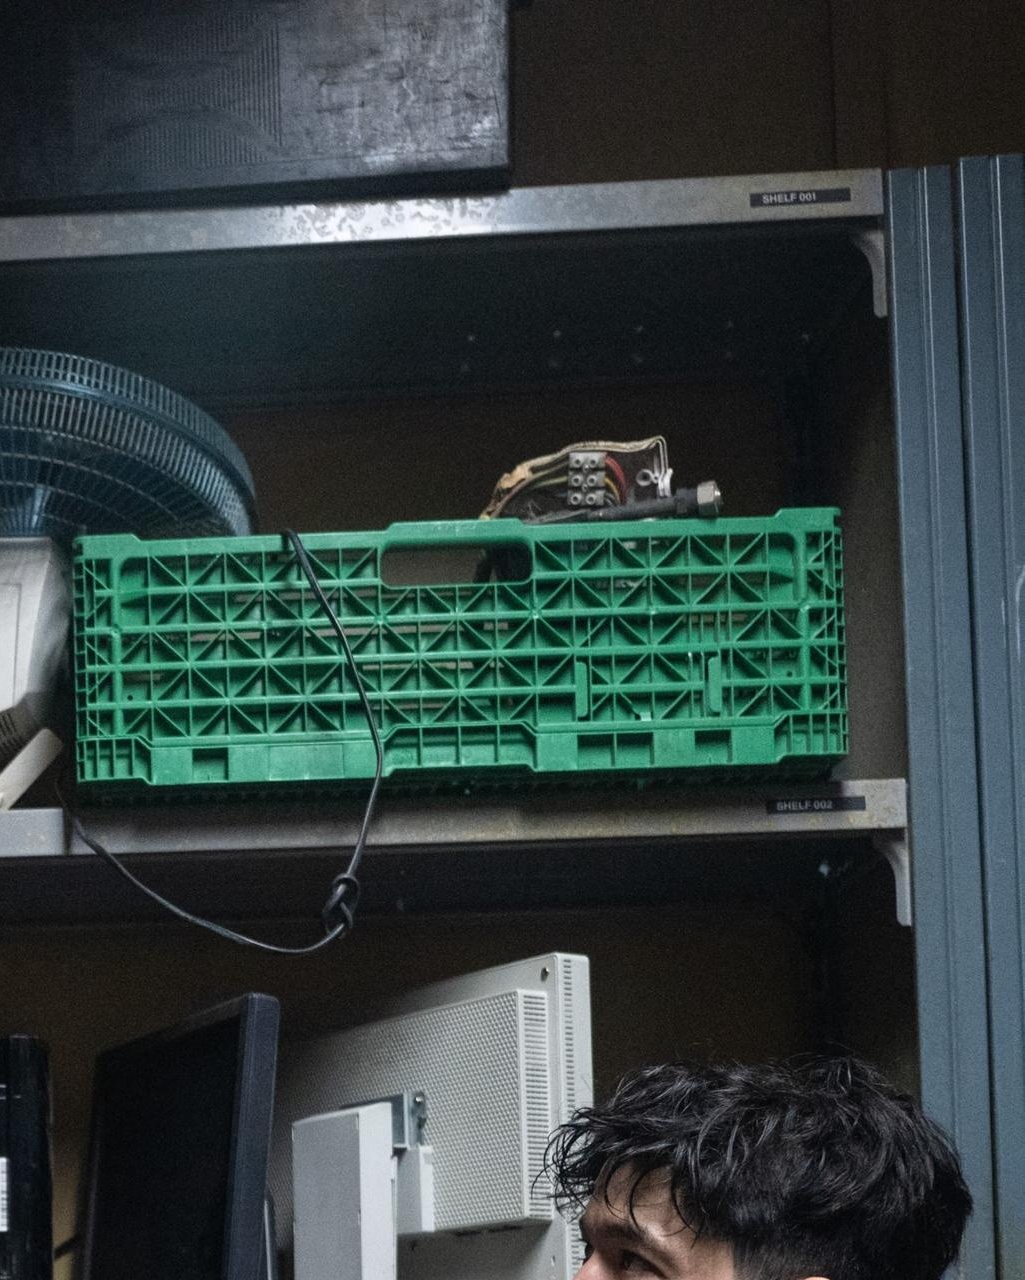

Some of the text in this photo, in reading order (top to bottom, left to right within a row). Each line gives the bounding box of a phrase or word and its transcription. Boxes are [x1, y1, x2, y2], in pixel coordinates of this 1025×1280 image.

[762, 191, 816, 204] SHELF 001
[777, 800, 833, 811] SHELF 002
